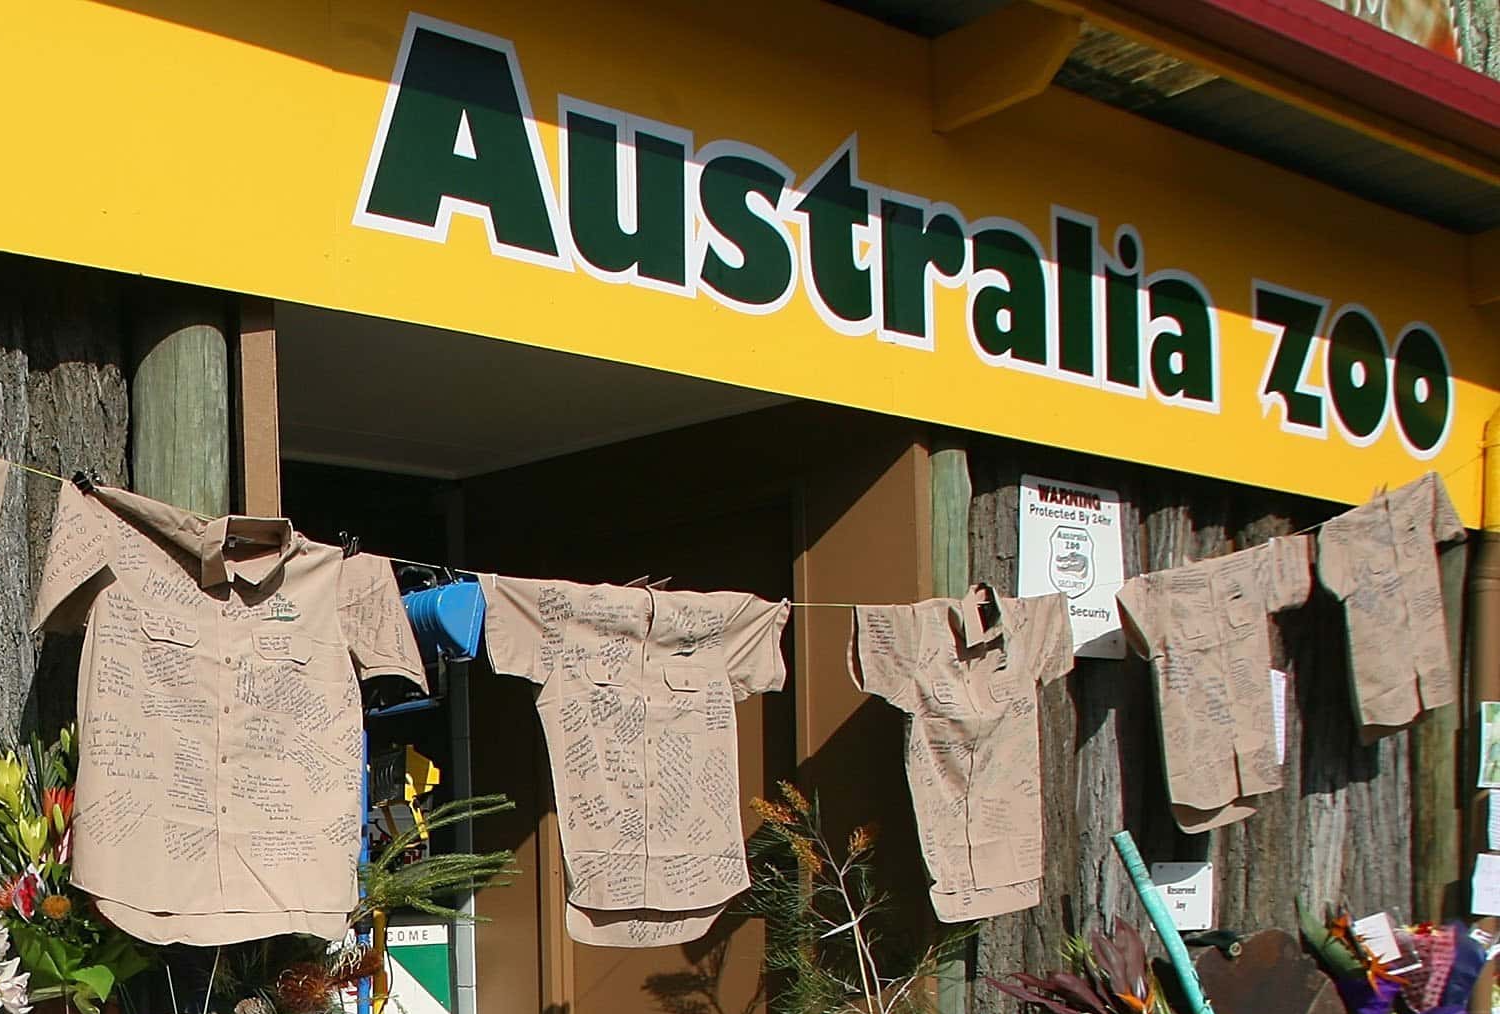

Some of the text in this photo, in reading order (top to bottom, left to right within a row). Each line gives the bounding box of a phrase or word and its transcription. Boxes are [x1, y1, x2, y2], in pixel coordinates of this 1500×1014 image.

[357, 14, 1218, 412] Australia
[1037, 483, 1102, 511] WARNING
[1029, 503, 1076, 521] Protected
[1079, 512, 1090, 524] By
[1069, 605, 1111, 621] Security
[387, 930, 429, 942] COME
